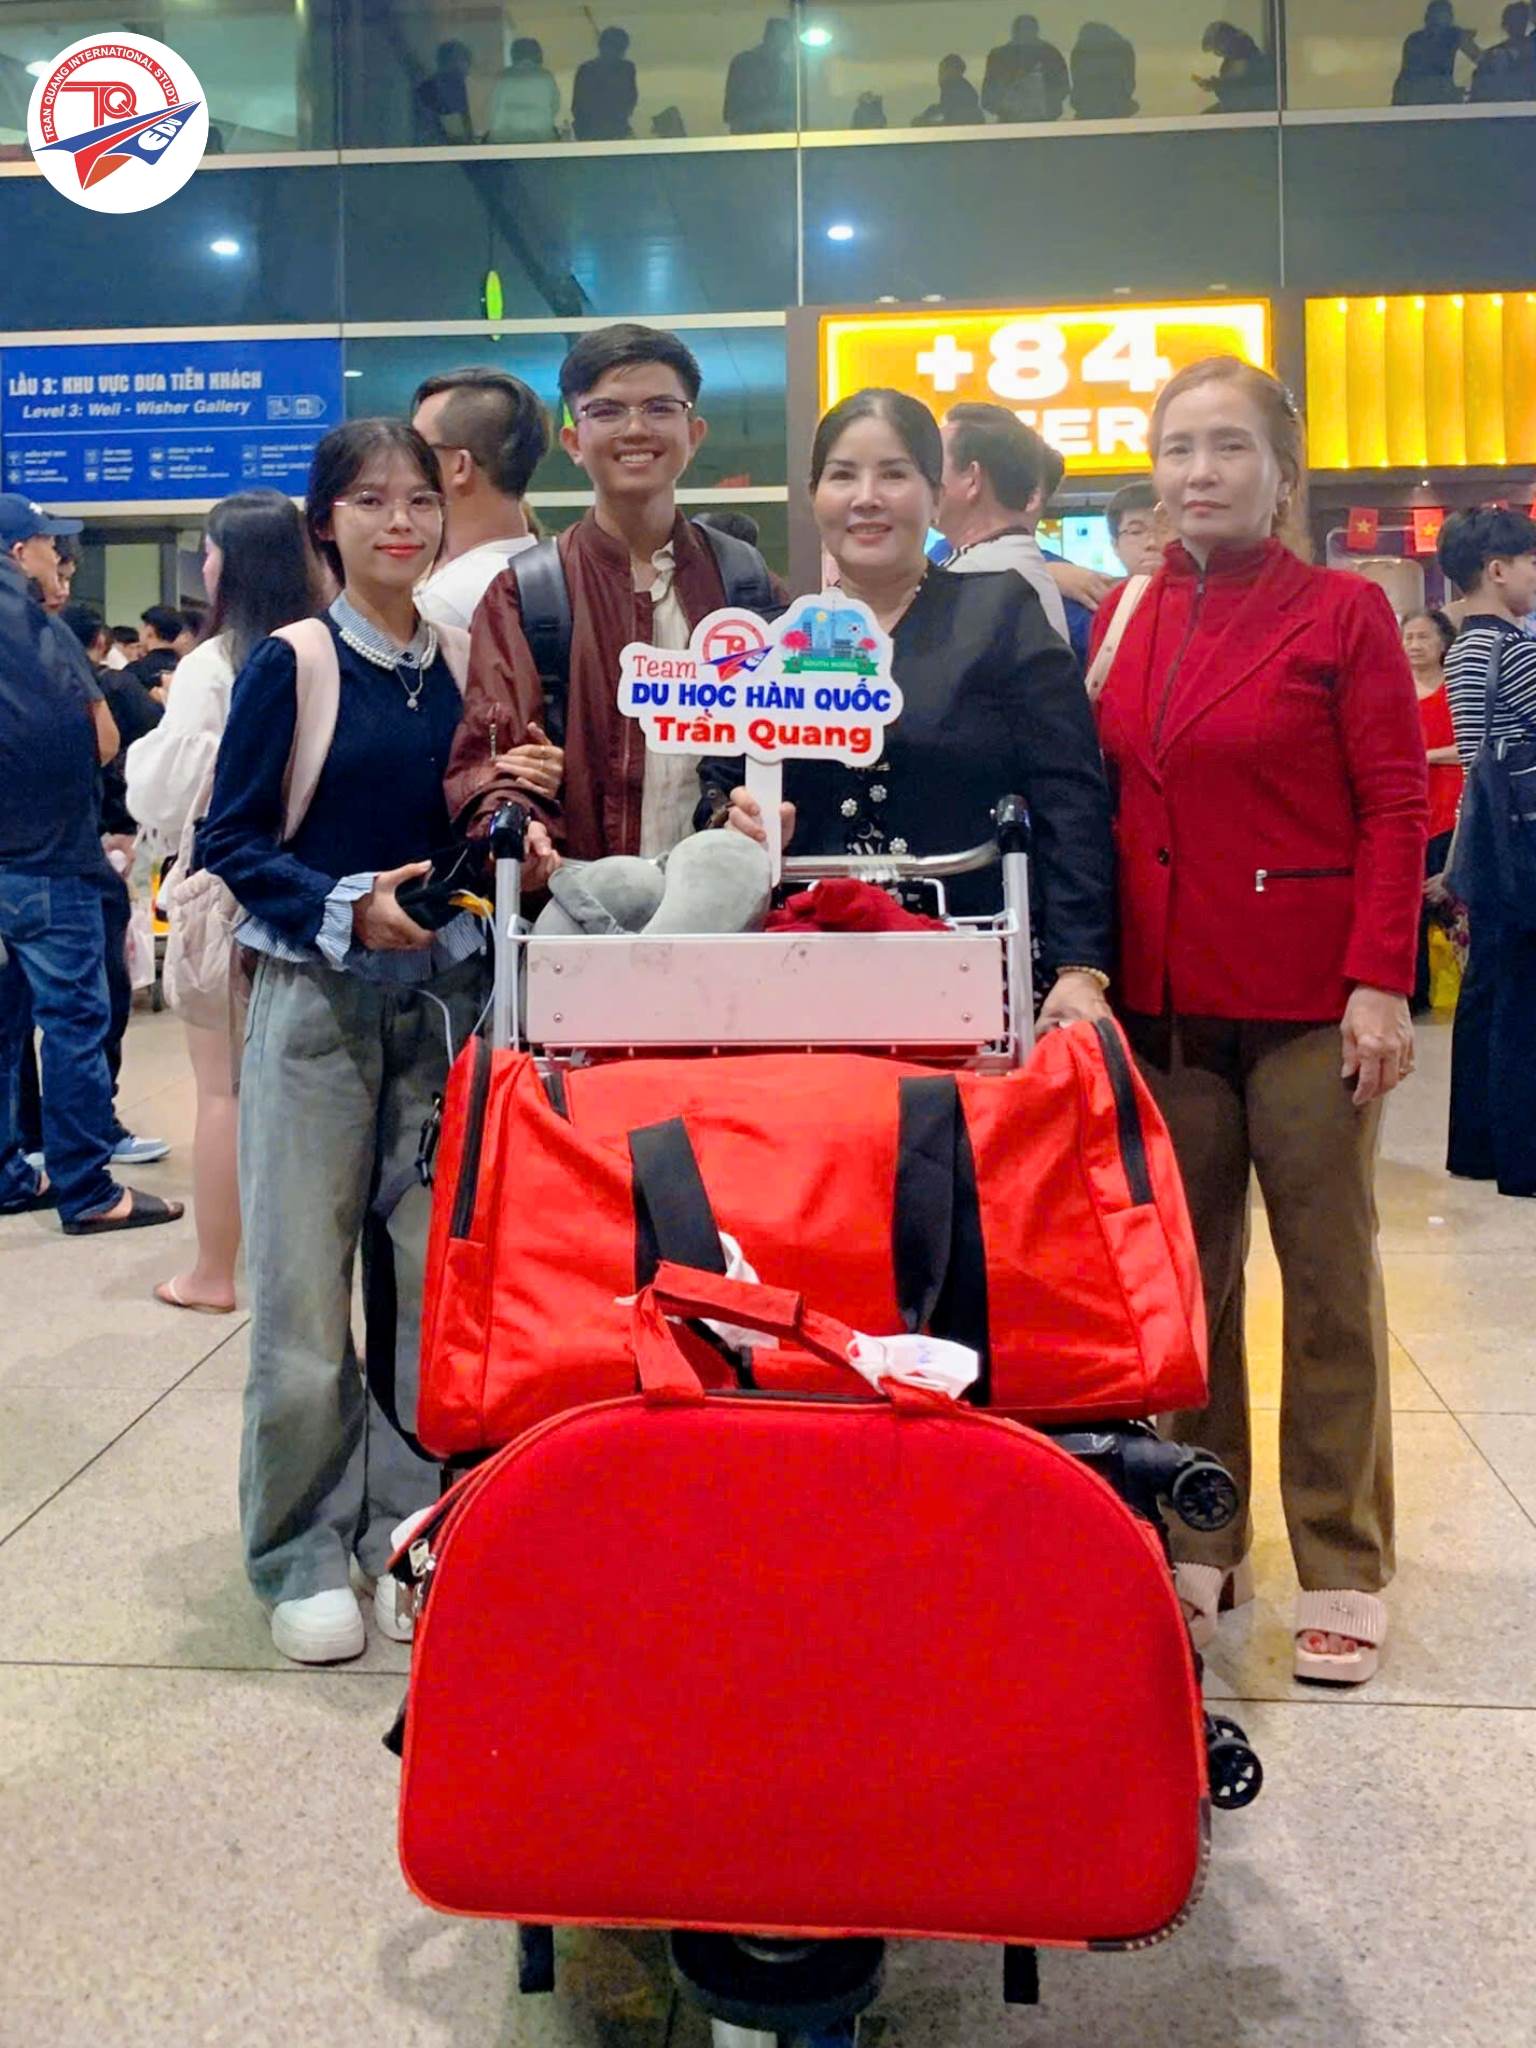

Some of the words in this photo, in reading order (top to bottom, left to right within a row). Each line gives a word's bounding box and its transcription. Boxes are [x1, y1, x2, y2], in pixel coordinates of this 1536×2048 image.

[916, 320, 1173, 400] +84
[41, 378, 58, 395] 3:
[62, 376, 94, 394] KHU
[23, 404, 64, 419] Level
[68, 404, 83, 418] 3:
[135, 400, 189, 415] Wisher
[193, 399, 251, 416] Gallery
[1013, 405, 1150, 455] ER
[632, 655, 697, 680] Team
[631, 683, 669, 706] DU
[679, 684, 737, 714] HỌC
[746, 682, 805, 710] HÀN
[815, 678, 891, 712] QUỐC
[654, 710, 736, 744] Trần
[748, 718, 872, 754] Quang
